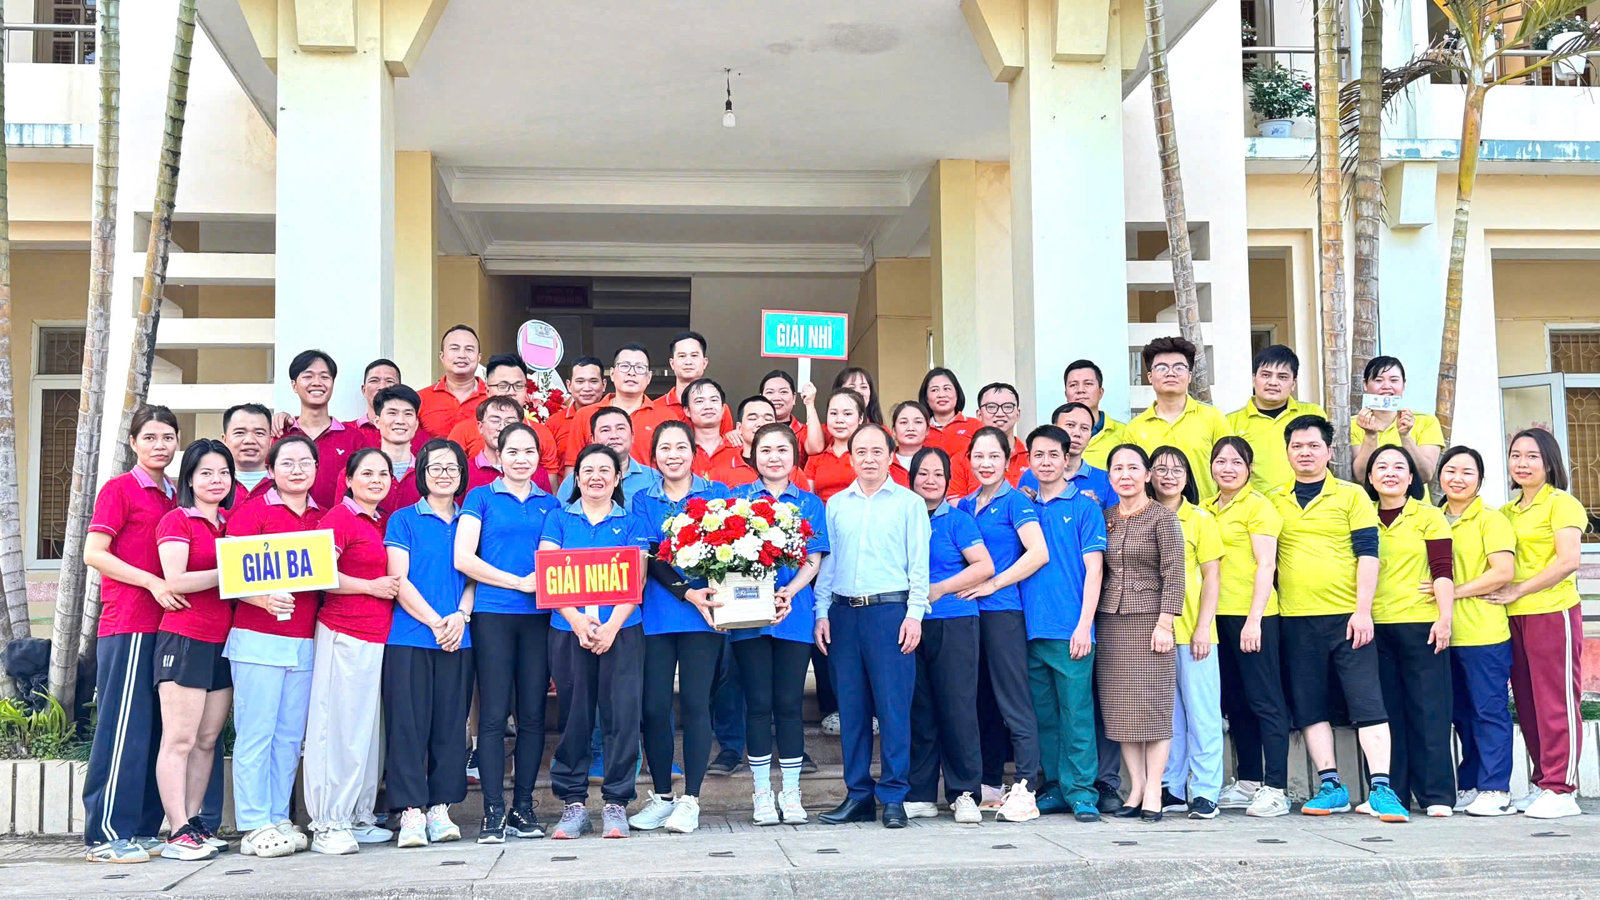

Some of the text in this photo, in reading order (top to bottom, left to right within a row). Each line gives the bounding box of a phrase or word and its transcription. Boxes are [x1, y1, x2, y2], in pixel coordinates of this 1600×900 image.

[776, 316, 833, 349] GIẢI NHÌ
[242, 541, 314, 583] GIẢI BA
[545, 552, 630, 596] GIẢI NHẤT
